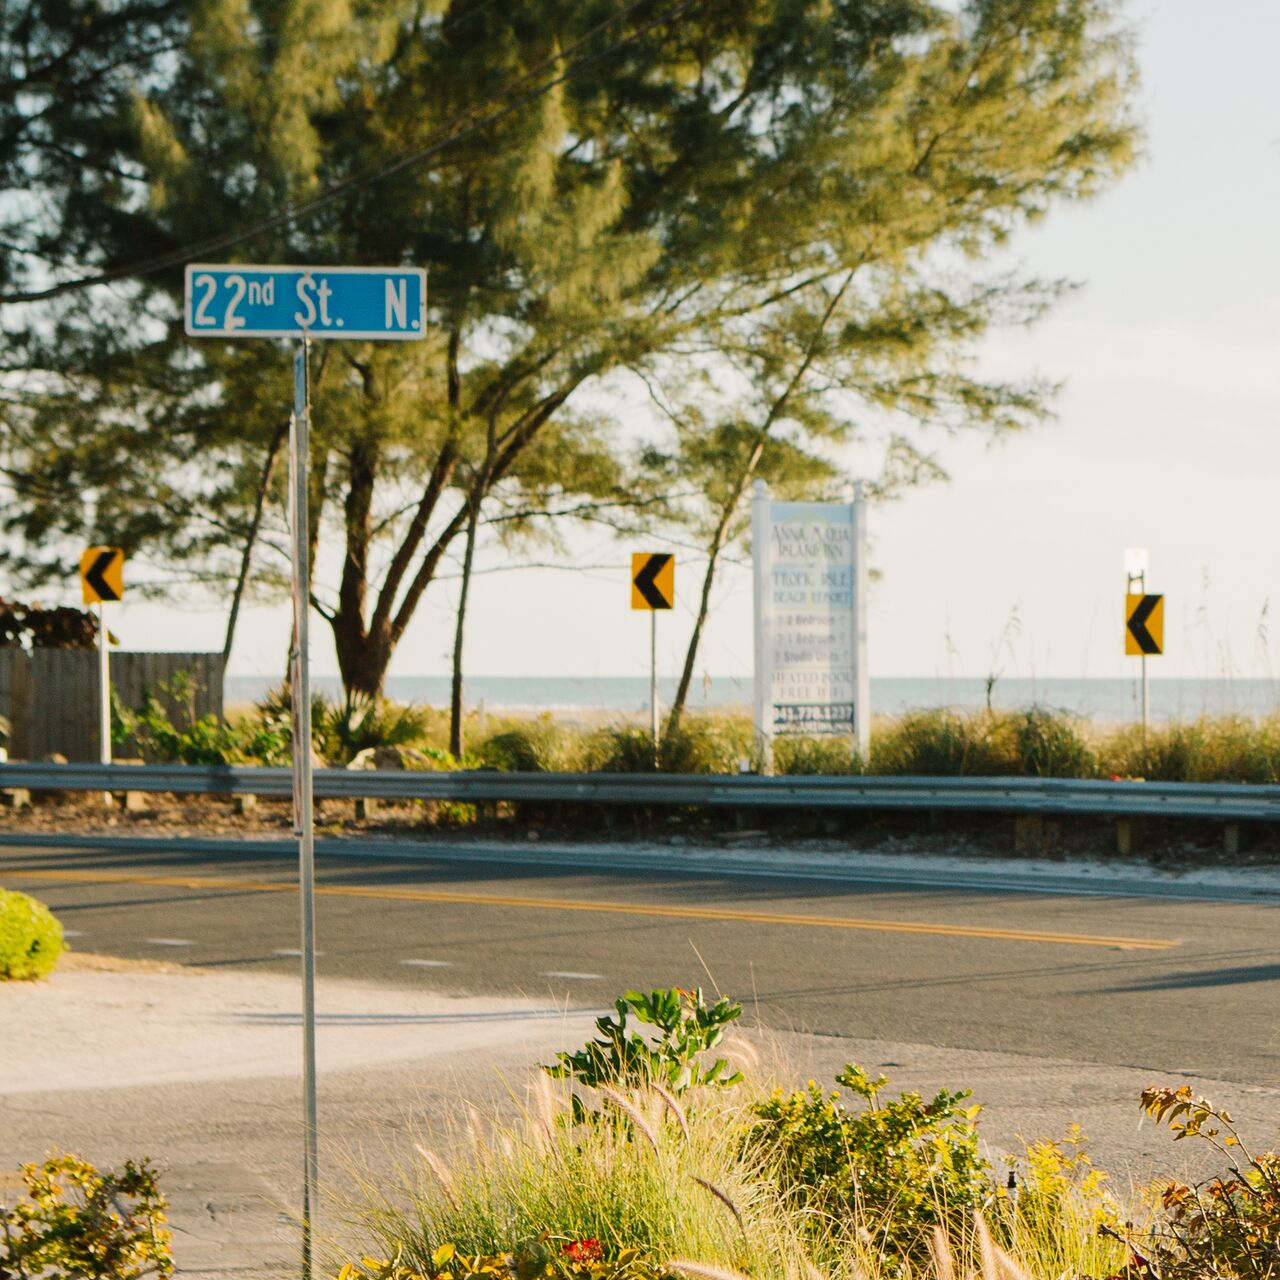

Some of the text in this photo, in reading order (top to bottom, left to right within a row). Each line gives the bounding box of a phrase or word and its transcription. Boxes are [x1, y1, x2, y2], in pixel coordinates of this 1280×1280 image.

[194, 274, 421, 332] 22nd St. N.
[771, 524, 807, 543] ANNA
[771, 671, 852, 684] HEATED POOL
[780, 687, 810, 699] FREE
